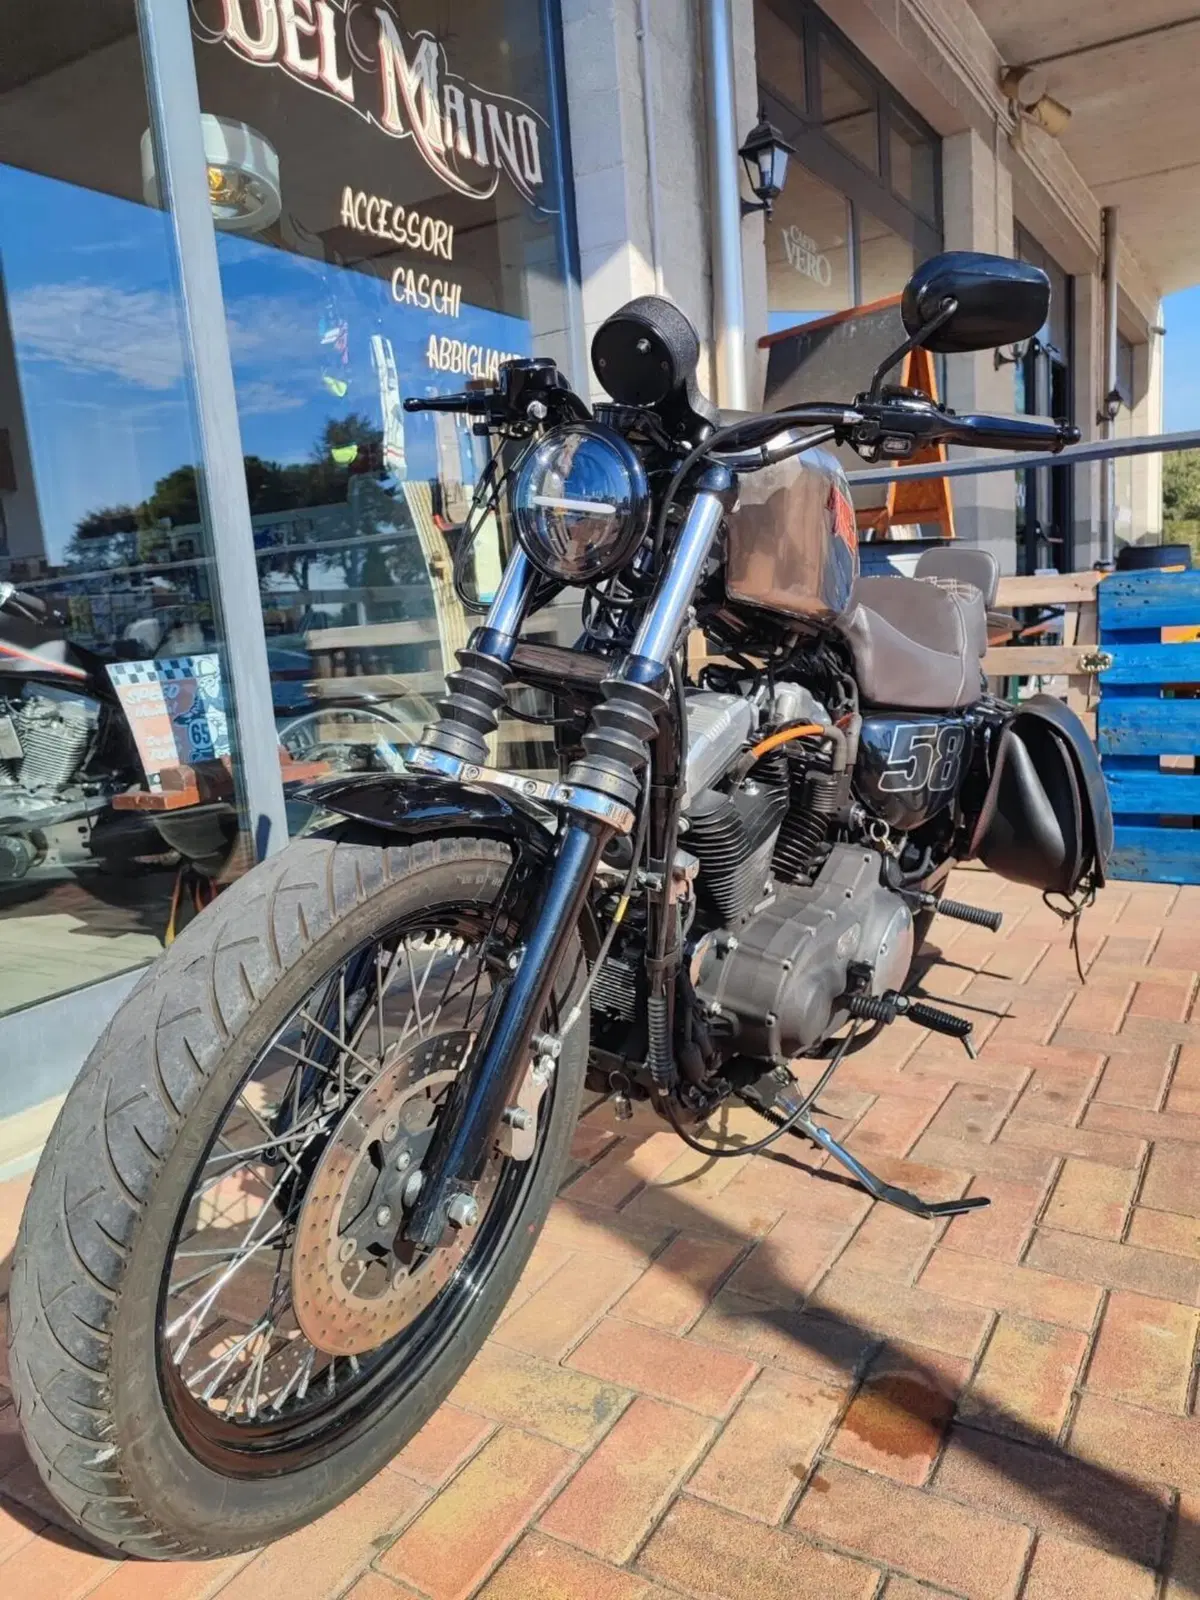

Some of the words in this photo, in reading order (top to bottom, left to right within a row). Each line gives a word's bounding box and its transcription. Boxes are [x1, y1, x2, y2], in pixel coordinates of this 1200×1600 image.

[373, 7, 543, 198] MAINO
[341, 185, 454, 260] ACCESSORI
[781, 227, 832, 288] VERO
[391, 266, 462, 318] CASCHI
[426, 333, 526, 381] ABBIGLIA
[190, 721, 211, 745] 65
[877, 723, 966, 792] 58
